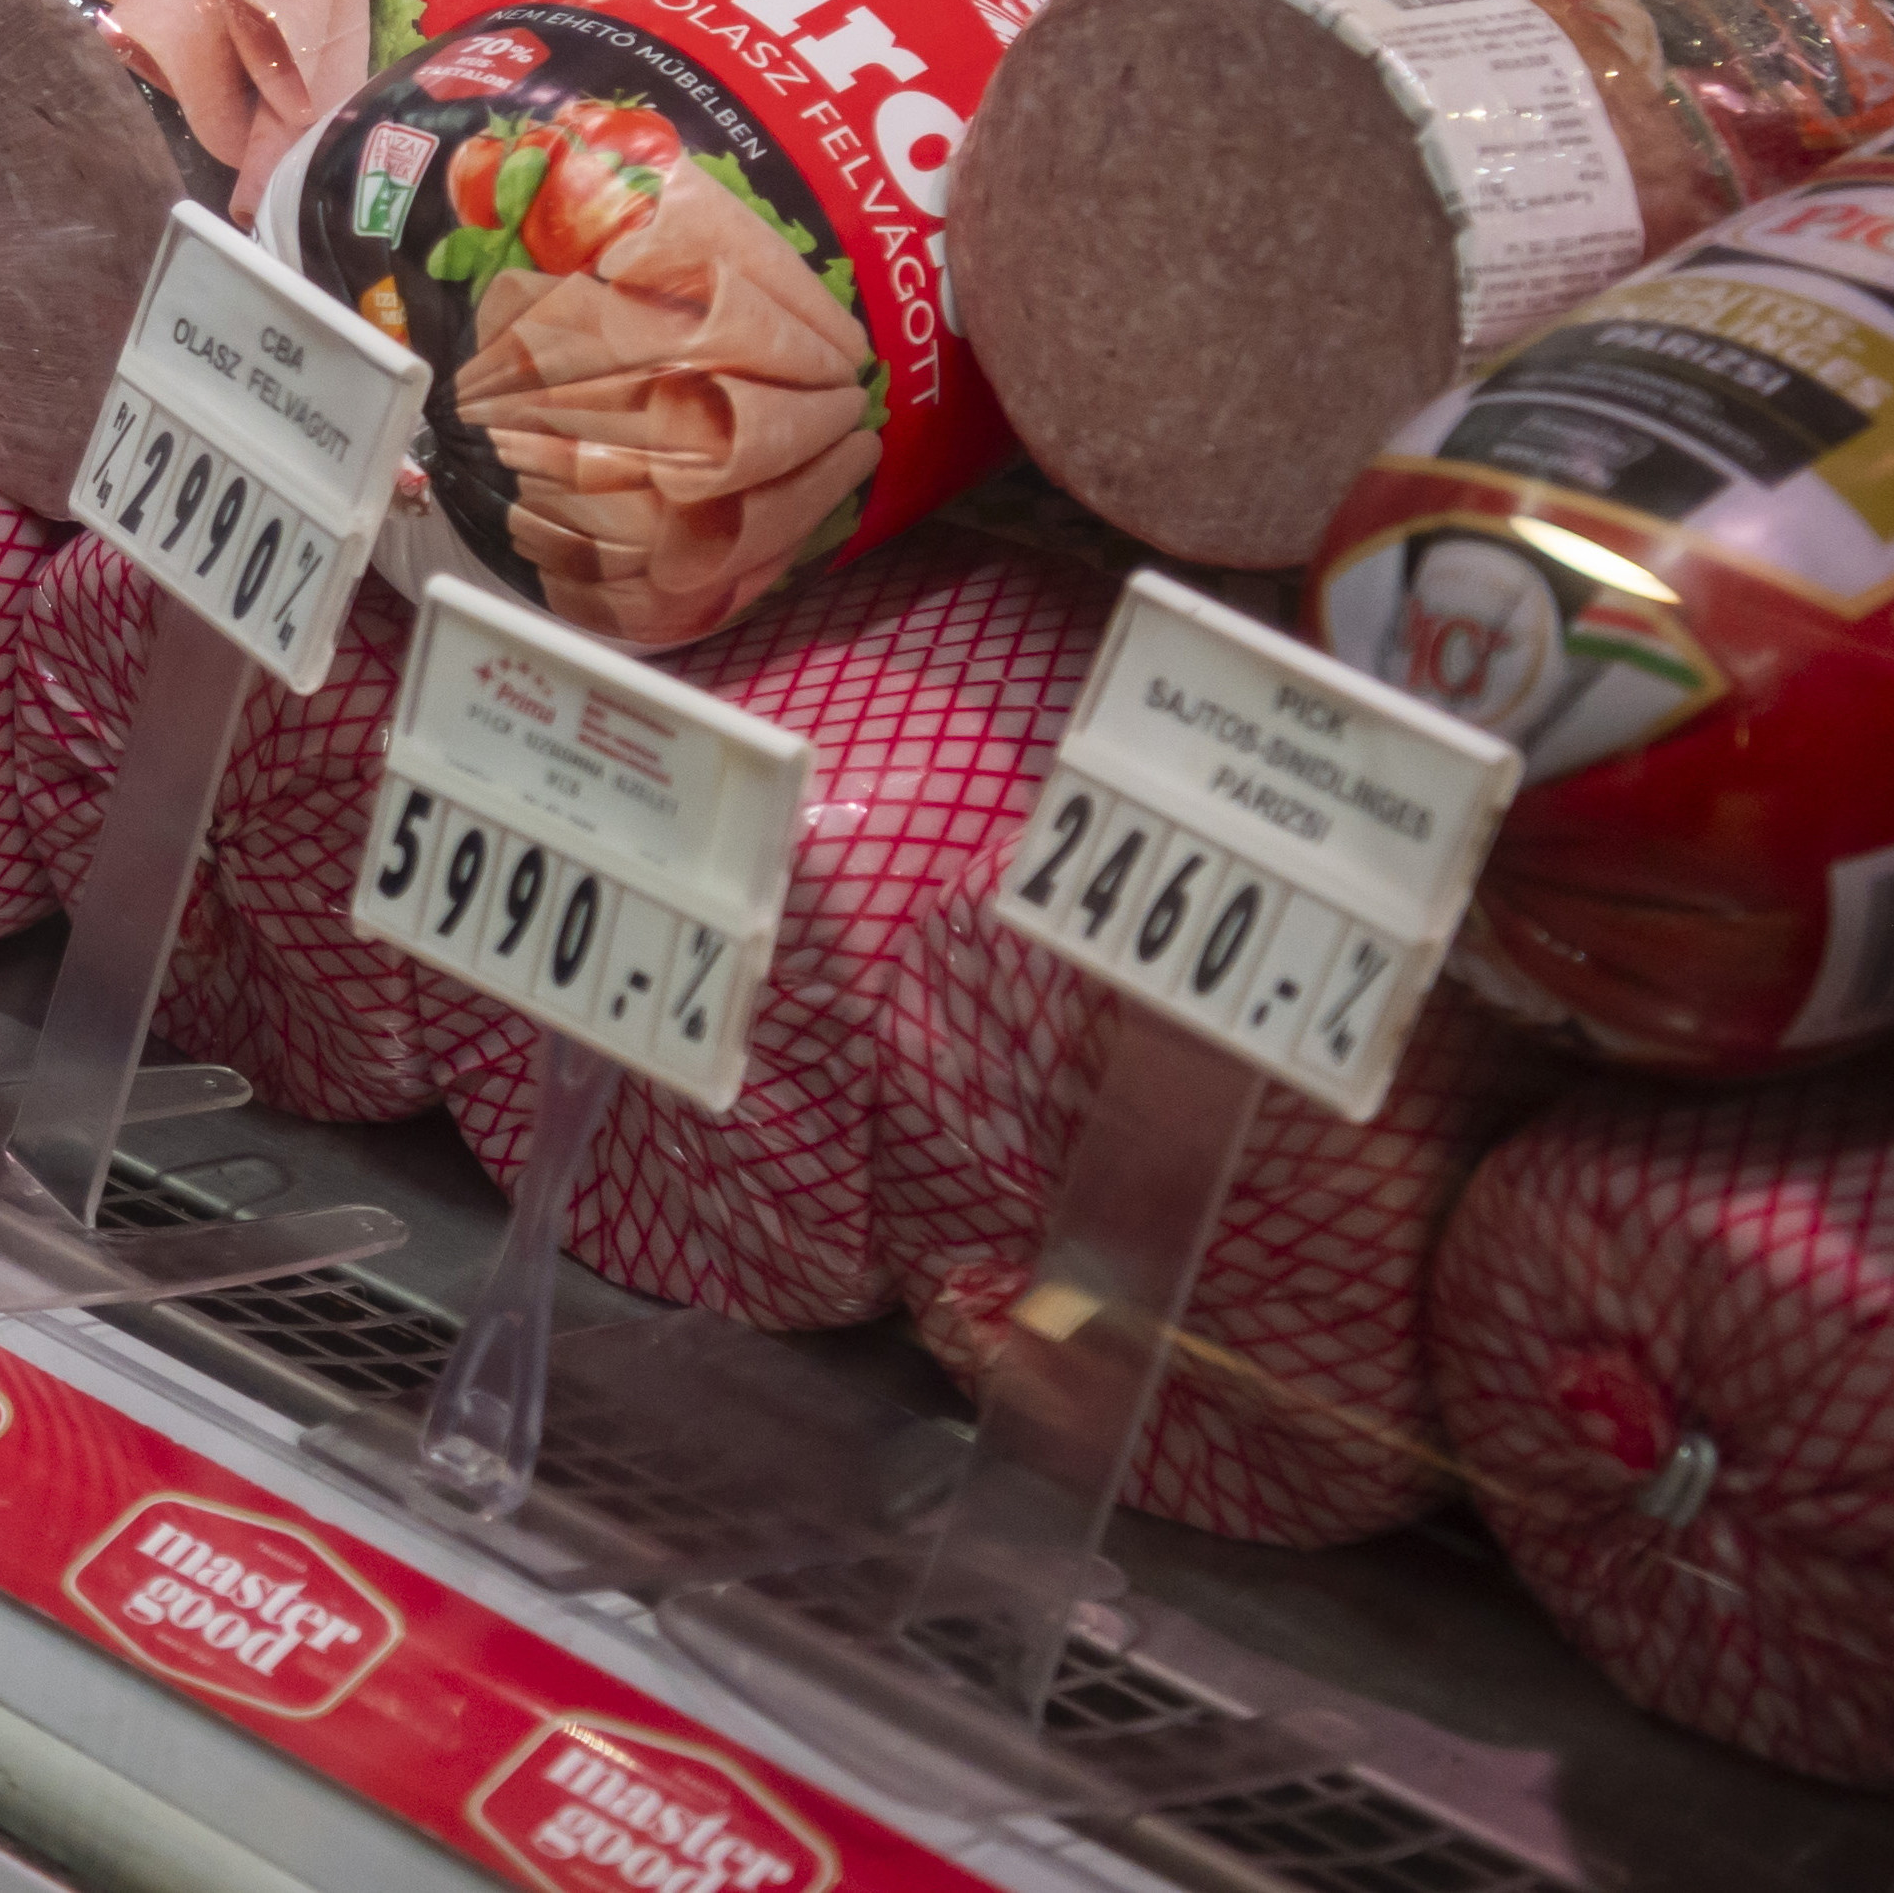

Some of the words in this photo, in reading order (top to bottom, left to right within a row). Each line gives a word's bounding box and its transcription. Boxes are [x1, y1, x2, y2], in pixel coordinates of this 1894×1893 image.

[465, 32, 536, 66] 70%
[489, 7, 544, 26] NEM
[545, 9, 638, 50] EHETŐ
[633, 40, 770, 163] MŰBÉLBEN
[799, 99, 945, 406] FELVÁGOTT
[170, 315, 244, 383] OLASZ
[246, 366, 353, 465] FELVÁGOTT
[258, 323, 307, 375] CBA
[116, 428, 287, 622] 2990
[1275, 684, 1348, 741] PICK
[1210, 763, 1337, 846] PÁRIZSI
[122, 1571, 301, 1680] good
[137, 1520, 362, 1655] master
[543, 1747, 794, 1892] master
